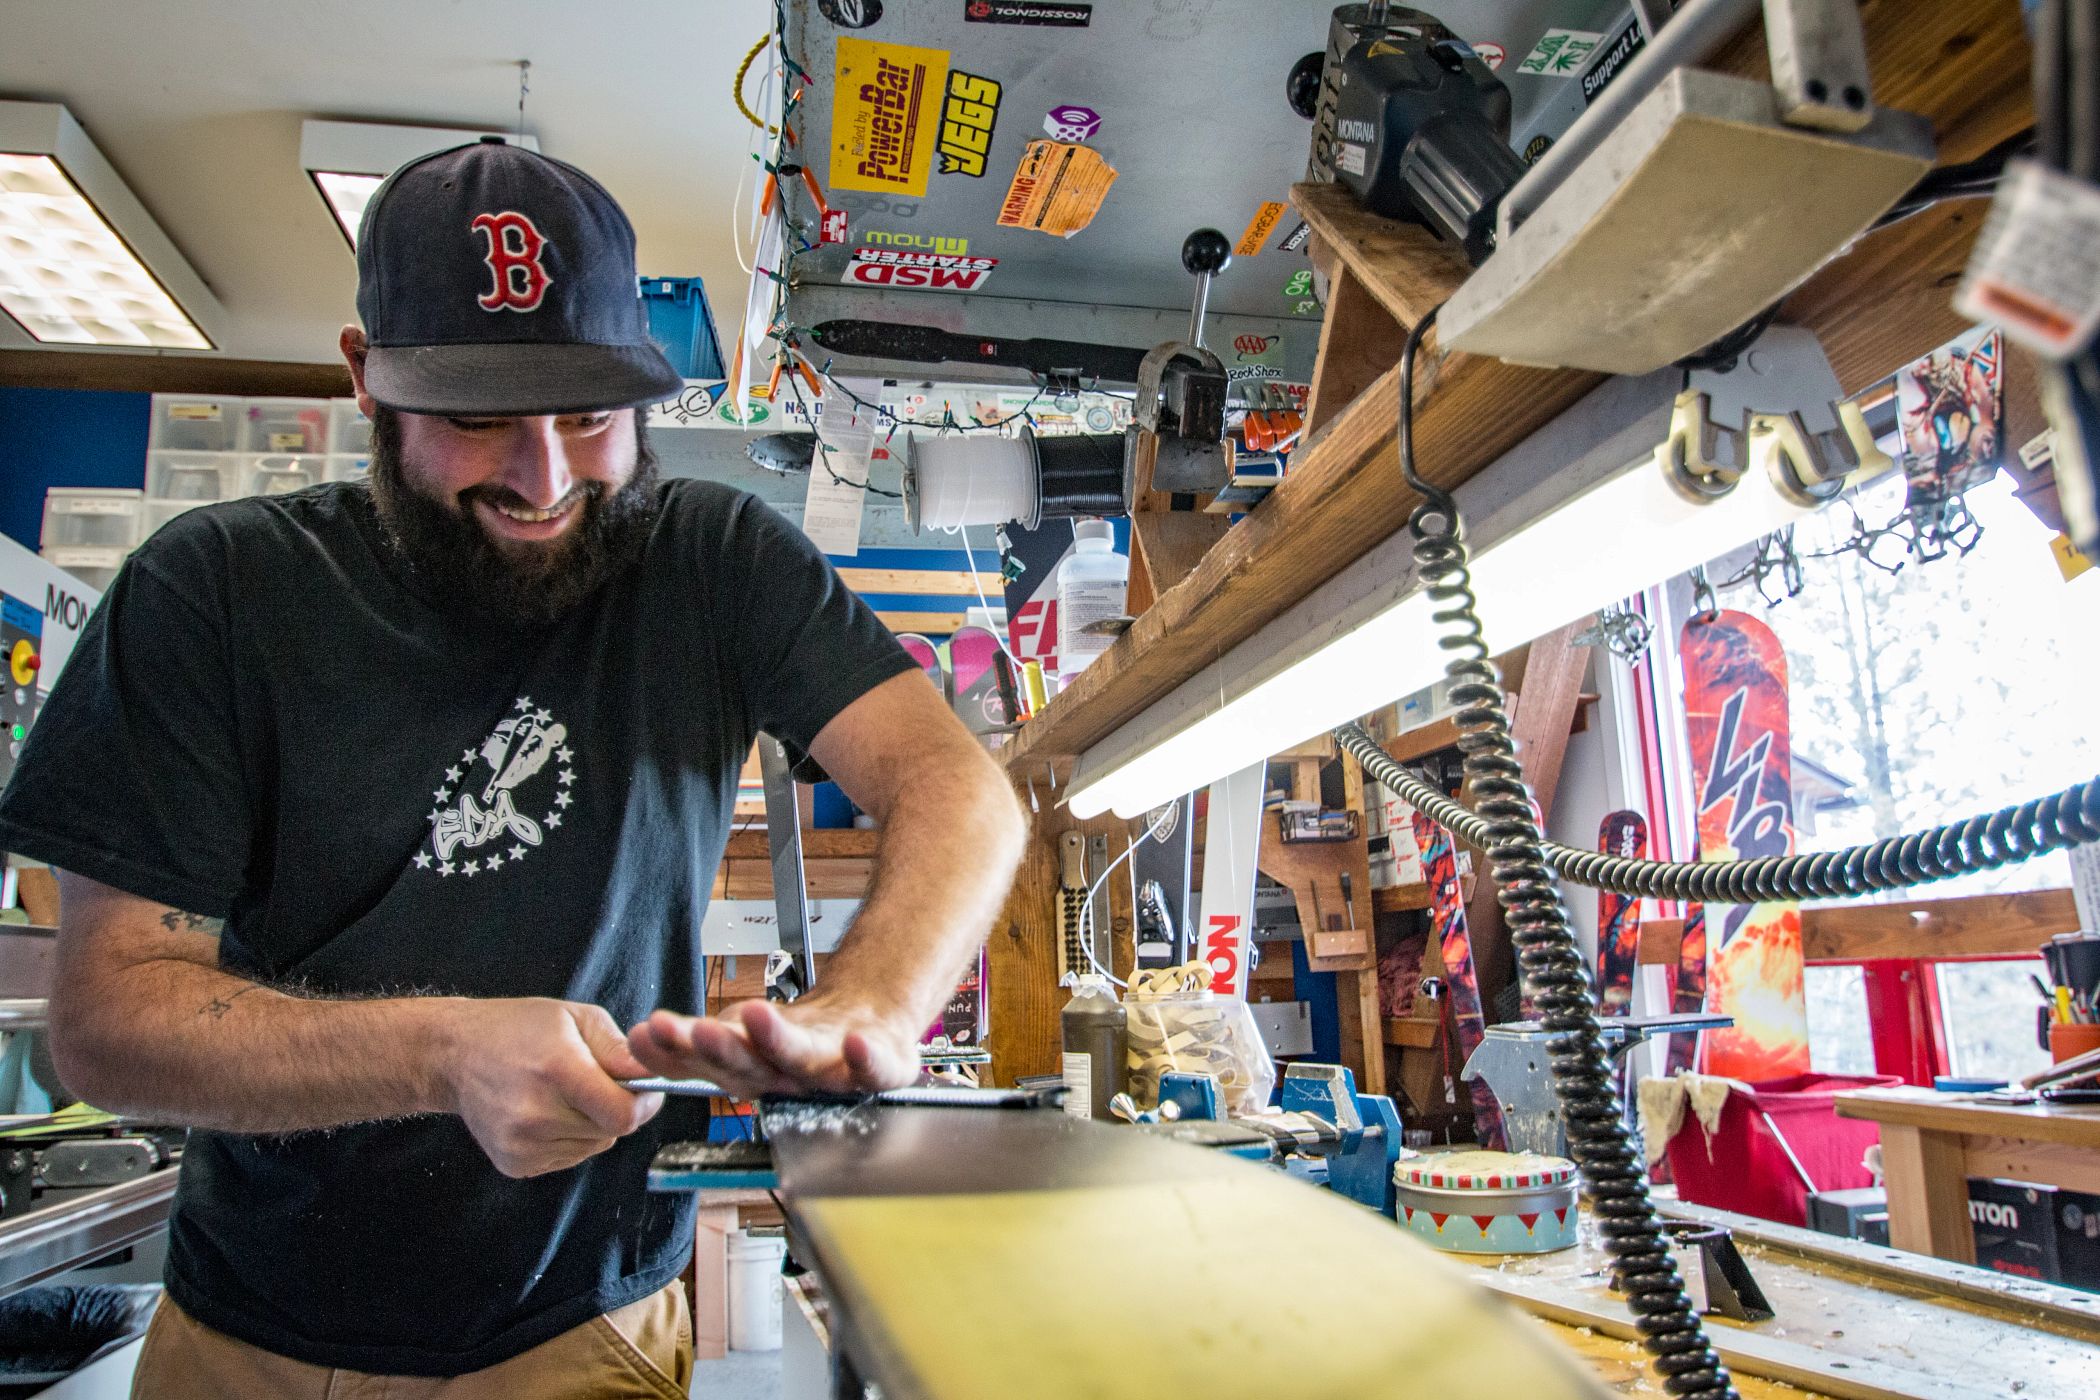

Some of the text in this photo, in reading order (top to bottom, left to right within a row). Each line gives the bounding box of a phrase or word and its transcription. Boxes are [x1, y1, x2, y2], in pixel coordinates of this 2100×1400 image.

[995, 6, 1089, 20] ROSSIGNOL
[1583, 38, 1629, 96] Support
[857, 57, 911, 185] PowerBar
[937, 69, 1003, 178] JEGS
[1337, 119, 1375, 143] MONTANA
[1000, 177, 1037, 225] WARNING
[471, 211, 553, 312] B
[854, 259, 982, 290] MSD
[859, 249, 993, 269] STARTER
